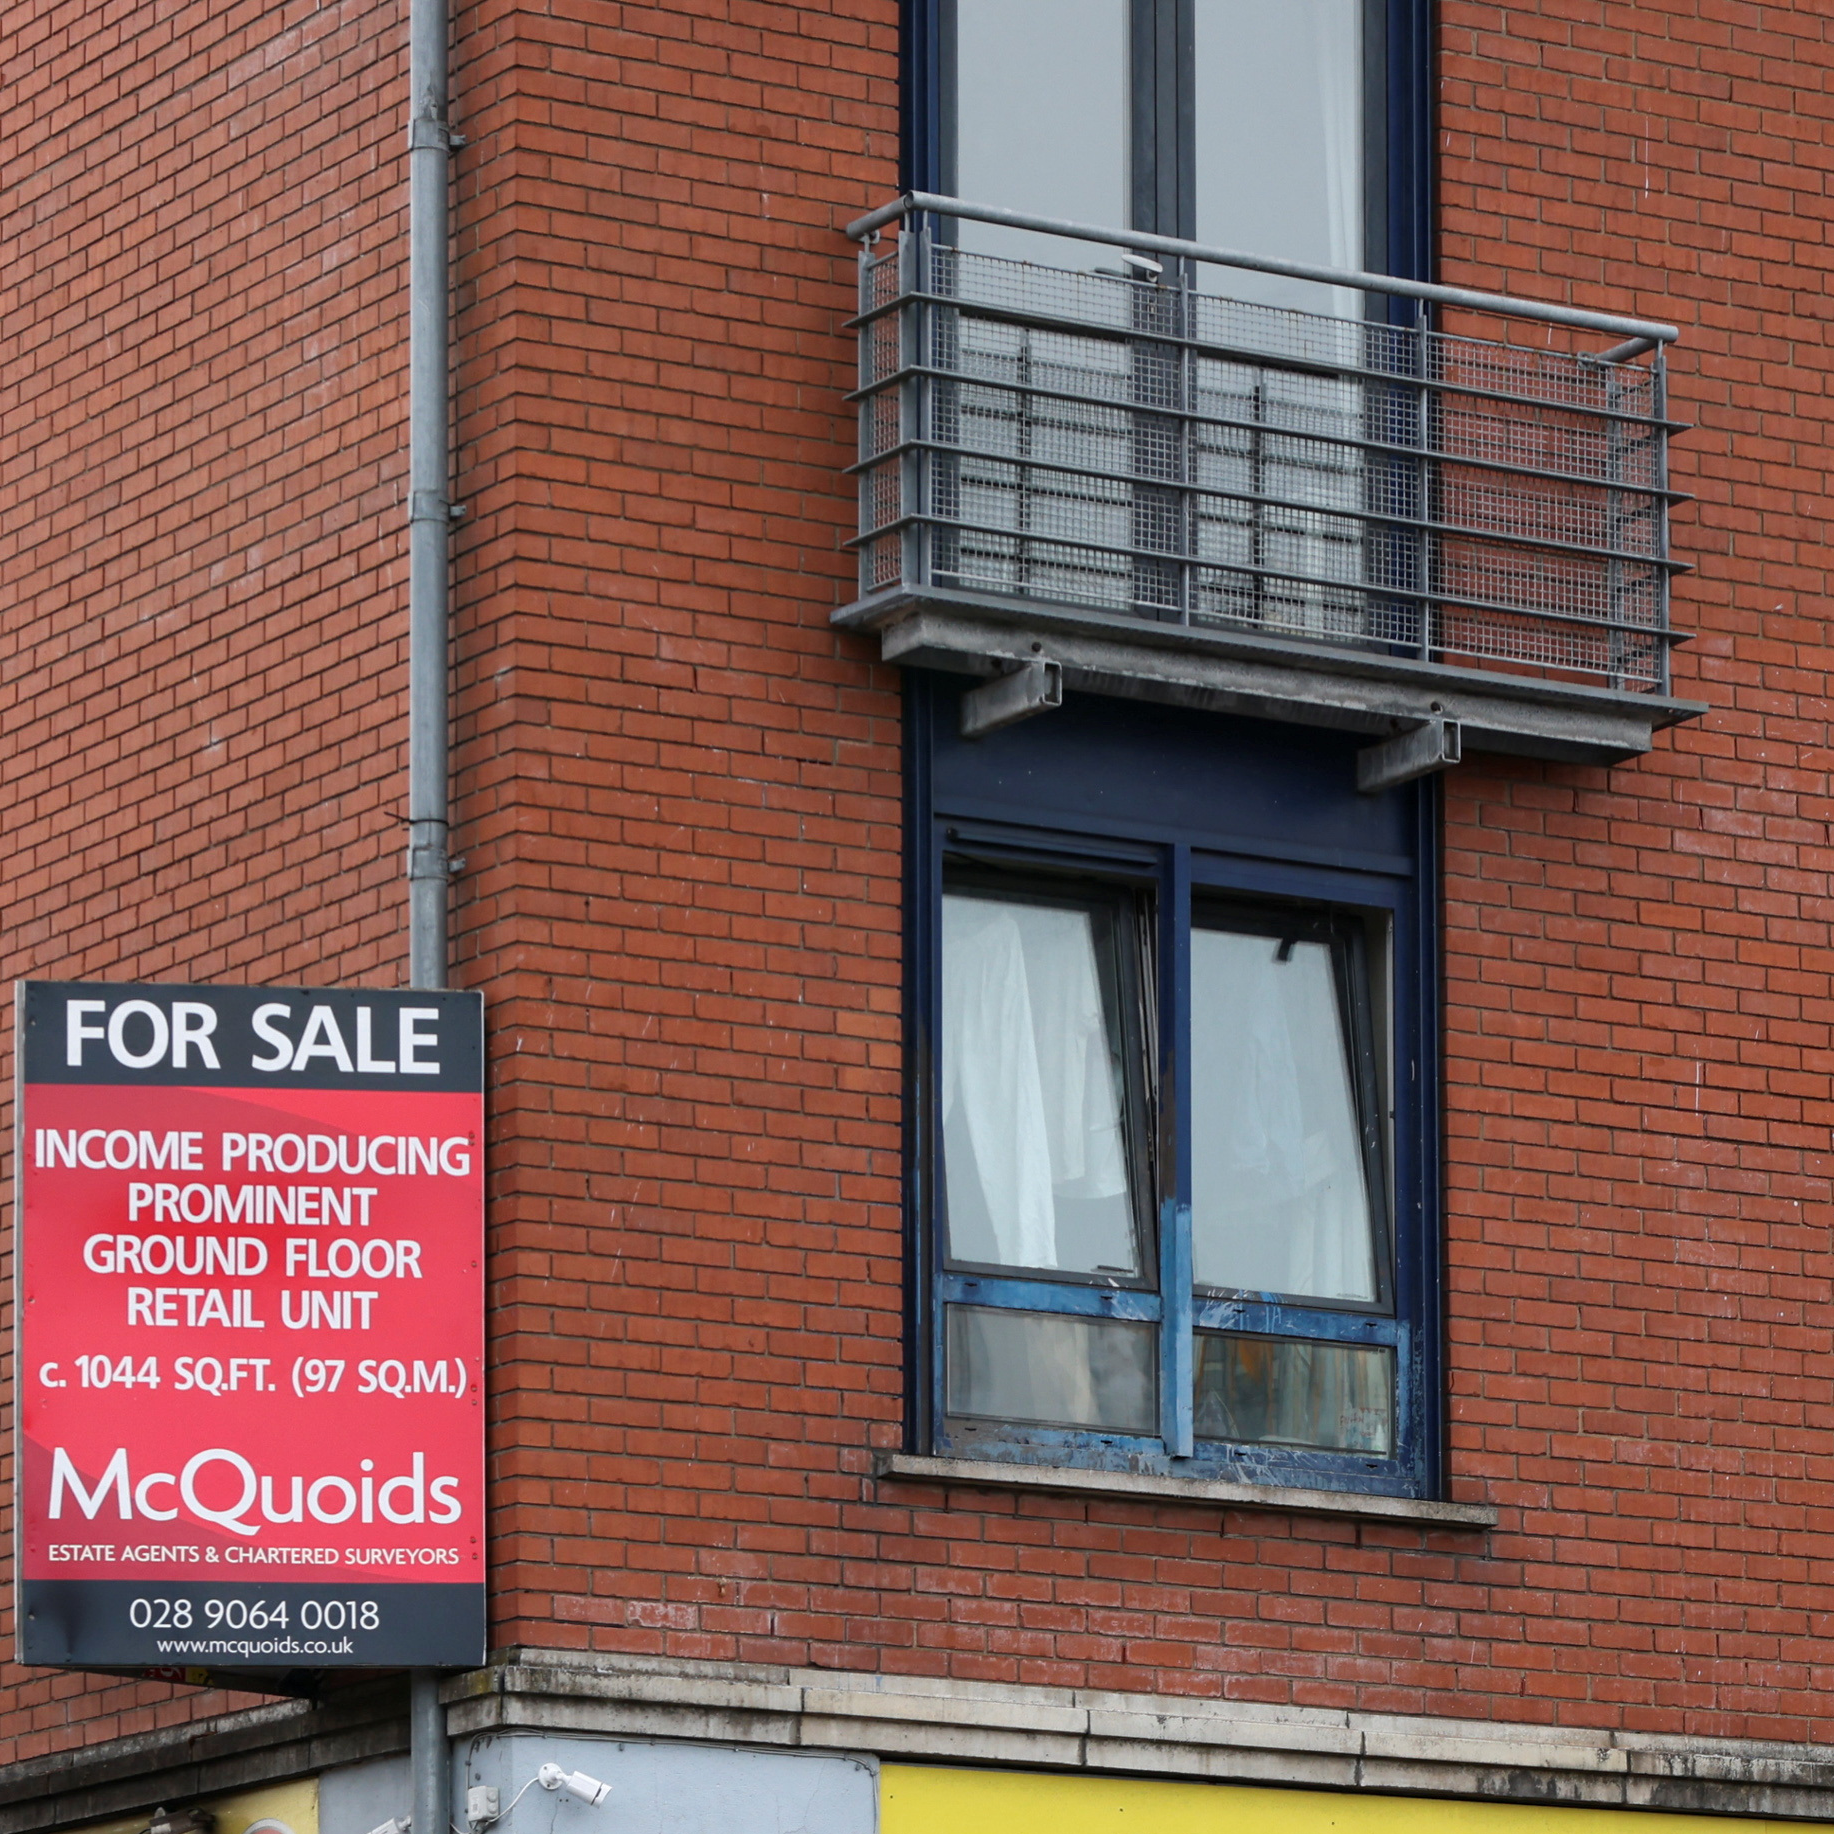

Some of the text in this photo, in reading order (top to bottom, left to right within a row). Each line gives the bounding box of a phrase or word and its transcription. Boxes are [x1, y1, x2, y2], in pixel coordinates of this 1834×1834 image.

[66, 999, 440, 1074] FOR SALE
[35, 1129, 471, 1176] INCOME PRODUCING
[128, 1182, 377, 1226] PROMINENT
[83, 1234, 422, 1278] GROUND FLOOR
[127, 1287, 377, 1330] RETAIL UNIT
[39, 1355, 466, 1398] c. 1044 SQ.FT. (97 SQ.M.)
[48, 1447, 462, 1536] McQuoids
[48, 1544, 459, 1565] ESTATE AGENTS & CHARTERED SURVEYORS
[129, 1598, 380, 1631] 028 9064 0018
[157, 1634, 353, 1657] www.mcquoids.co.uk
